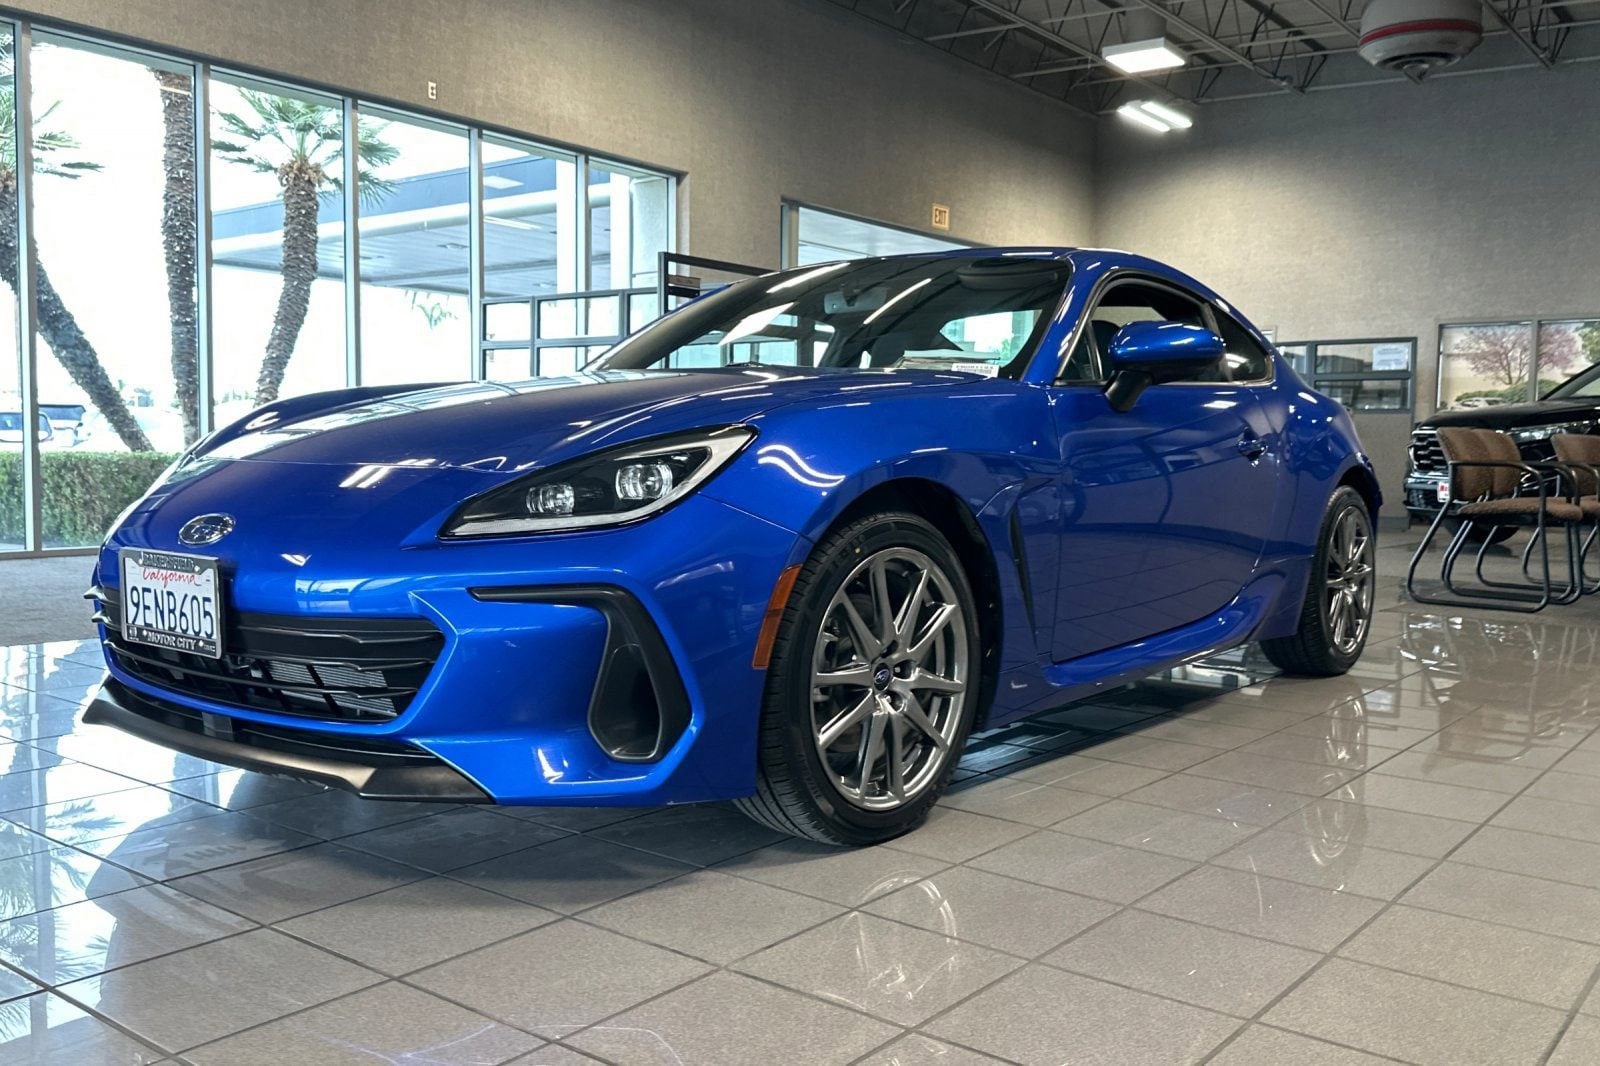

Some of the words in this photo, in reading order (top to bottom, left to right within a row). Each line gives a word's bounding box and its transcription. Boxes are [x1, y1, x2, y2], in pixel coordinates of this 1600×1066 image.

[934, 206, 947, 226] EXIT
[143, 567, 201, 588] California
[130, 585, 214, 640] 9ENB605
[147, 631, 175, 646] MOTOR
[176, 638, 197, 650] CITY
